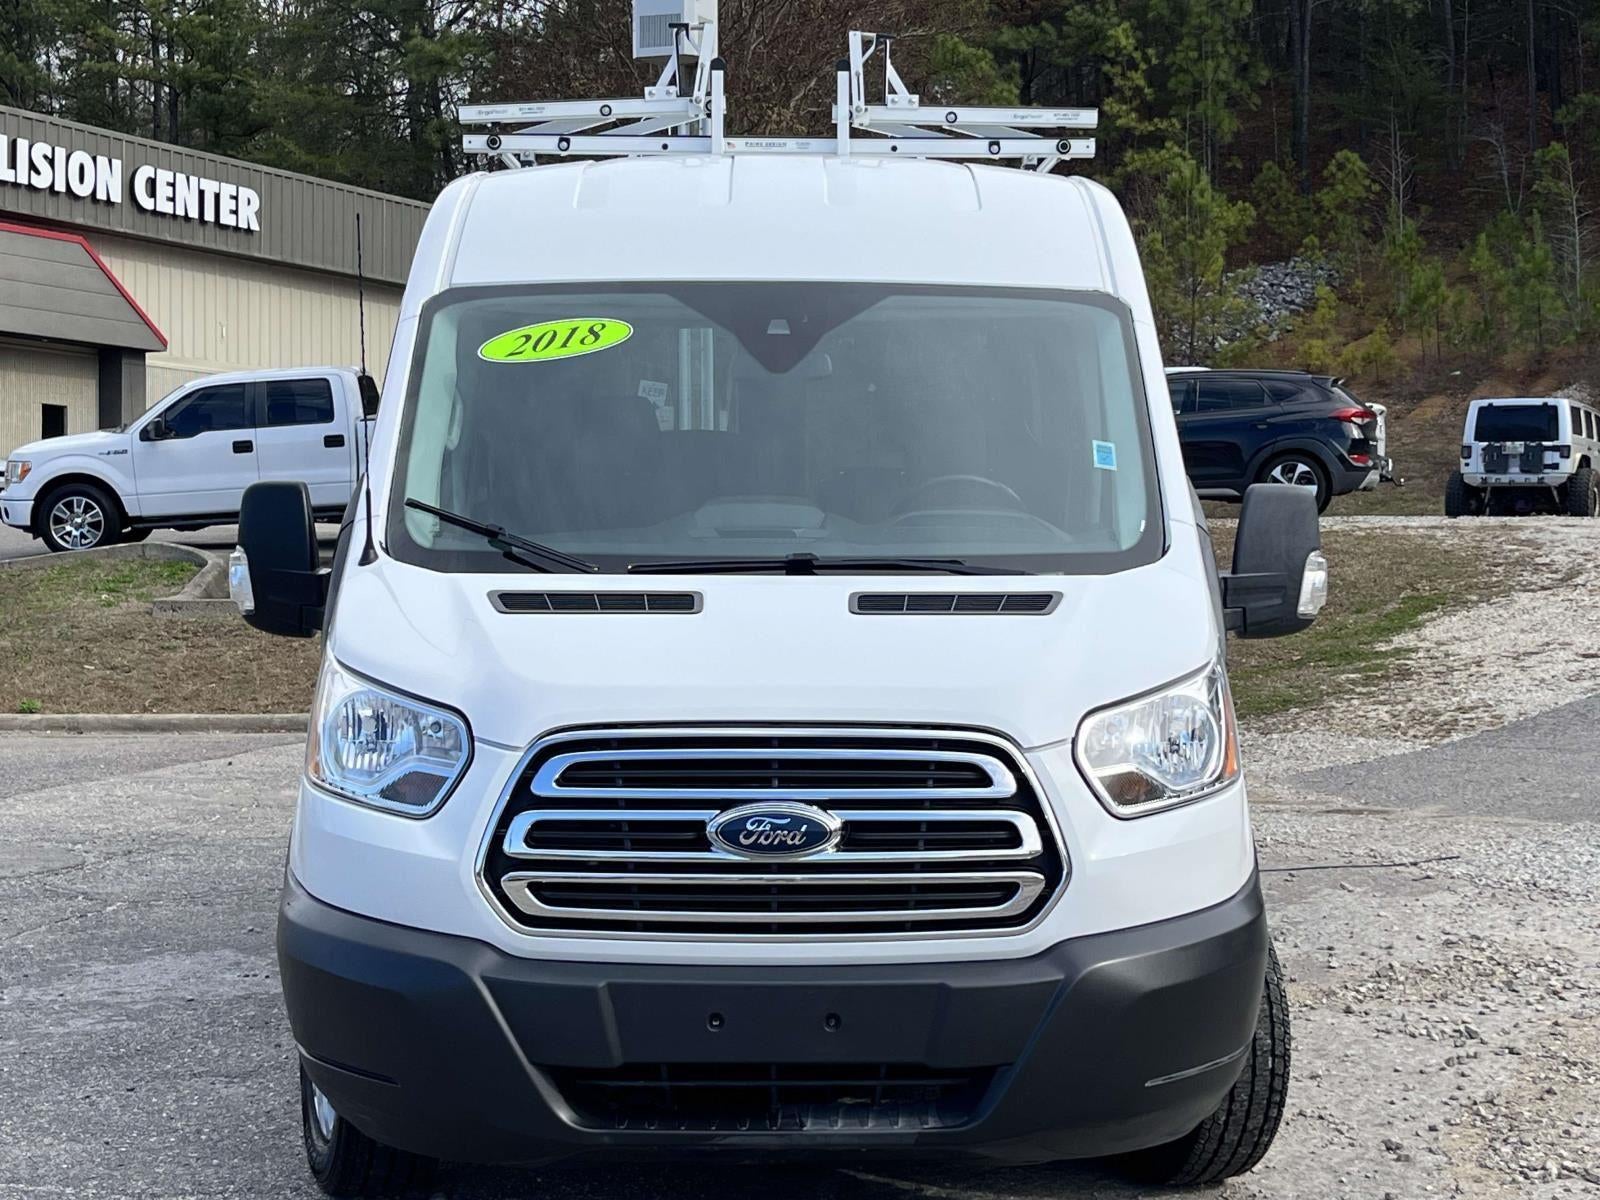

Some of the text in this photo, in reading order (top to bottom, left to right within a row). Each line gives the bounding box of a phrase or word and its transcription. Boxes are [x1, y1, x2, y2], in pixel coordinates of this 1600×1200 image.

[0, 133, 261, 232] LISION CENTER
[504, 322, 607, 358] 2018
[738, 816, 808, 846] Ford
